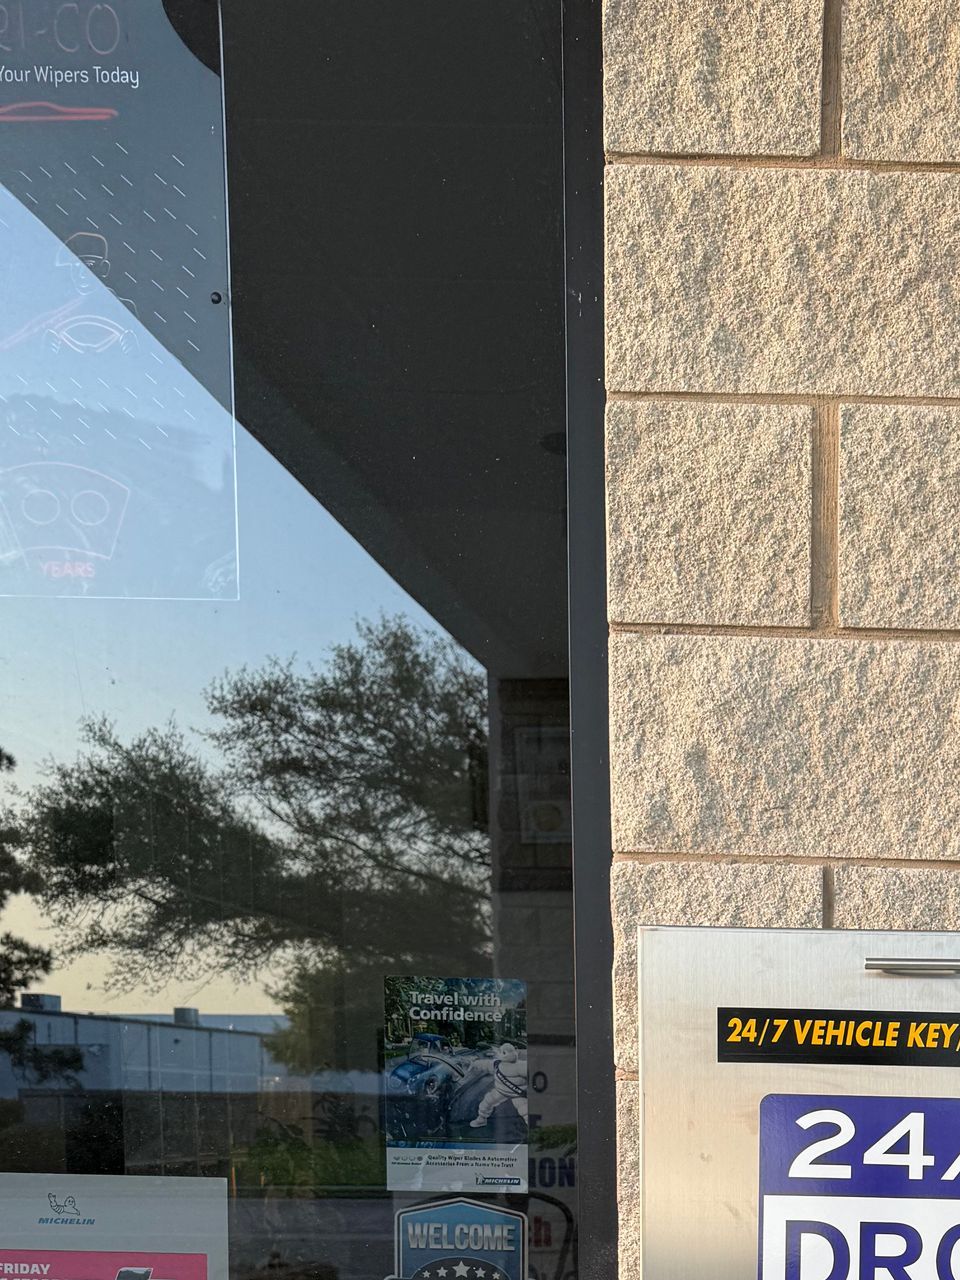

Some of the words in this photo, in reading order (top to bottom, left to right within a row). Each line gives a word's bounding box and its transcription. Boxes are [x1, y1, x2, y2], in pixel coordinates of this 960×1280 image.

[33, 65, 90, 88] Wipers
[92, 65, 140, 89] Today
[39, 560, 96, 578] YEARS
[409, 991, 459, 1005] Travel
[464, 992, 502, 1006] with
[408, 1006, 503, 1022] Confidence
[726, 1017, 789, 1046] 24/7
[793, 1019, 900, 1047] VEHICLE
[427, 1154, 447, 1162] Quality
[448, 1154, 464, 1162] Wiper
[38, 1217, 96, 1226] MICHELIN
[407, 1222, 516, 1251] WELCOME
